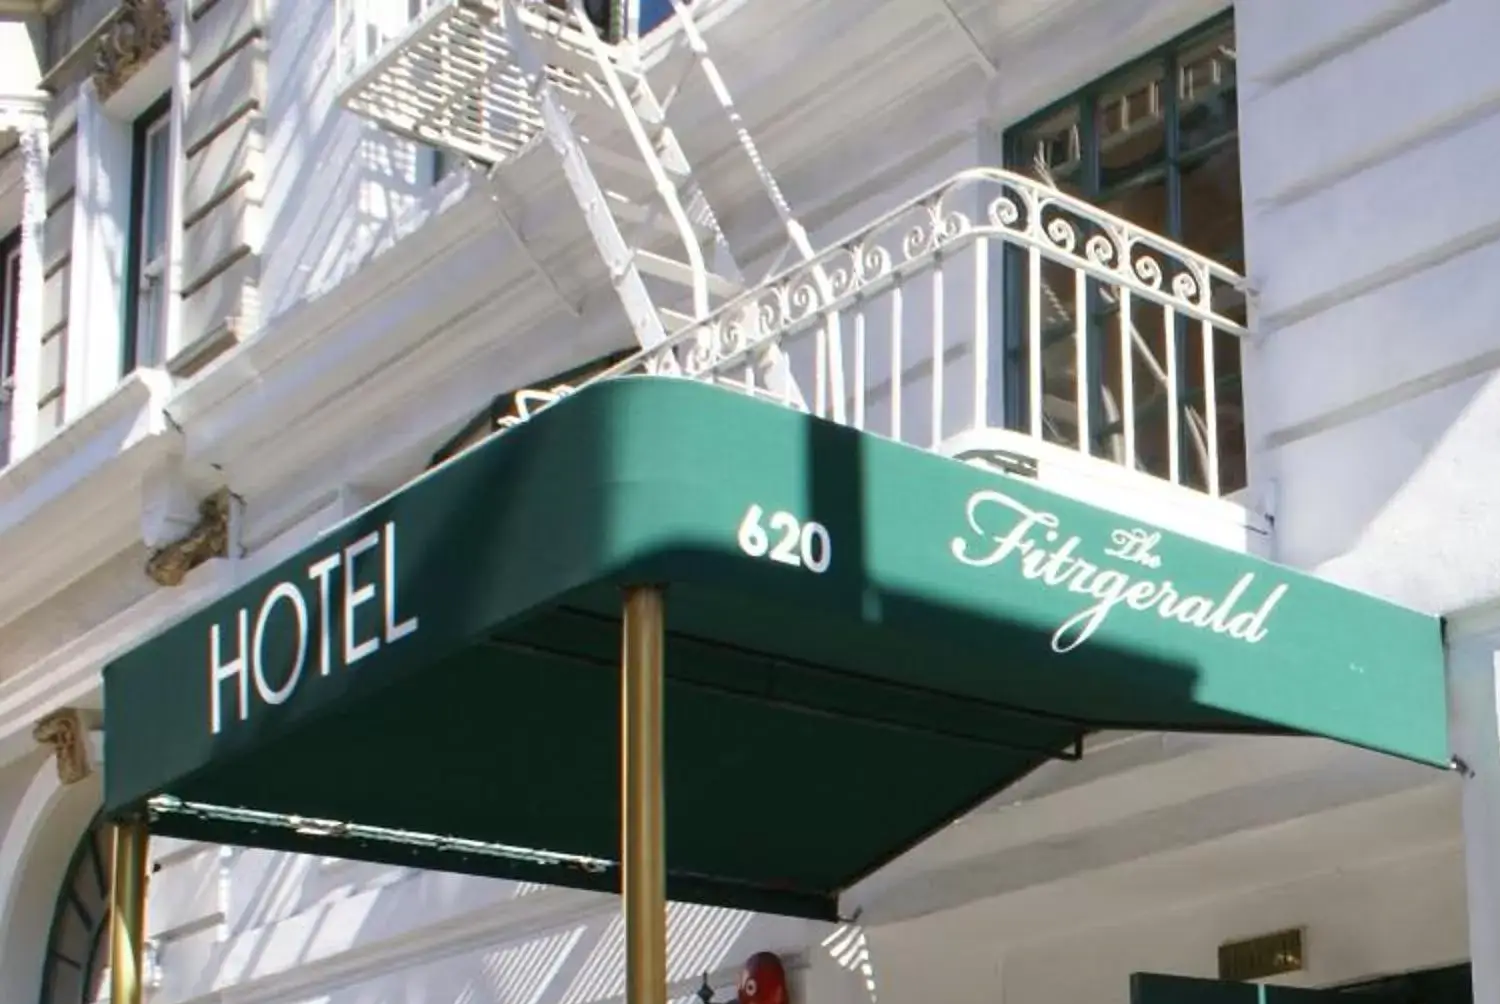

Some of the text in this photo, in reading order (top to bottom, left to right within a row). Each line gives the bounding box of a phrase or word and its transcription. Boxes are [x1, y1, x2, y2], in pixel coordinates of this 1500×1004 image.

[738, 504, 831, 572] 620
[951, 490, 1289, 653] Fitzgerald
[1104, 528, 1162, 568] The
[210, 521, 418, 734] HOTEL
